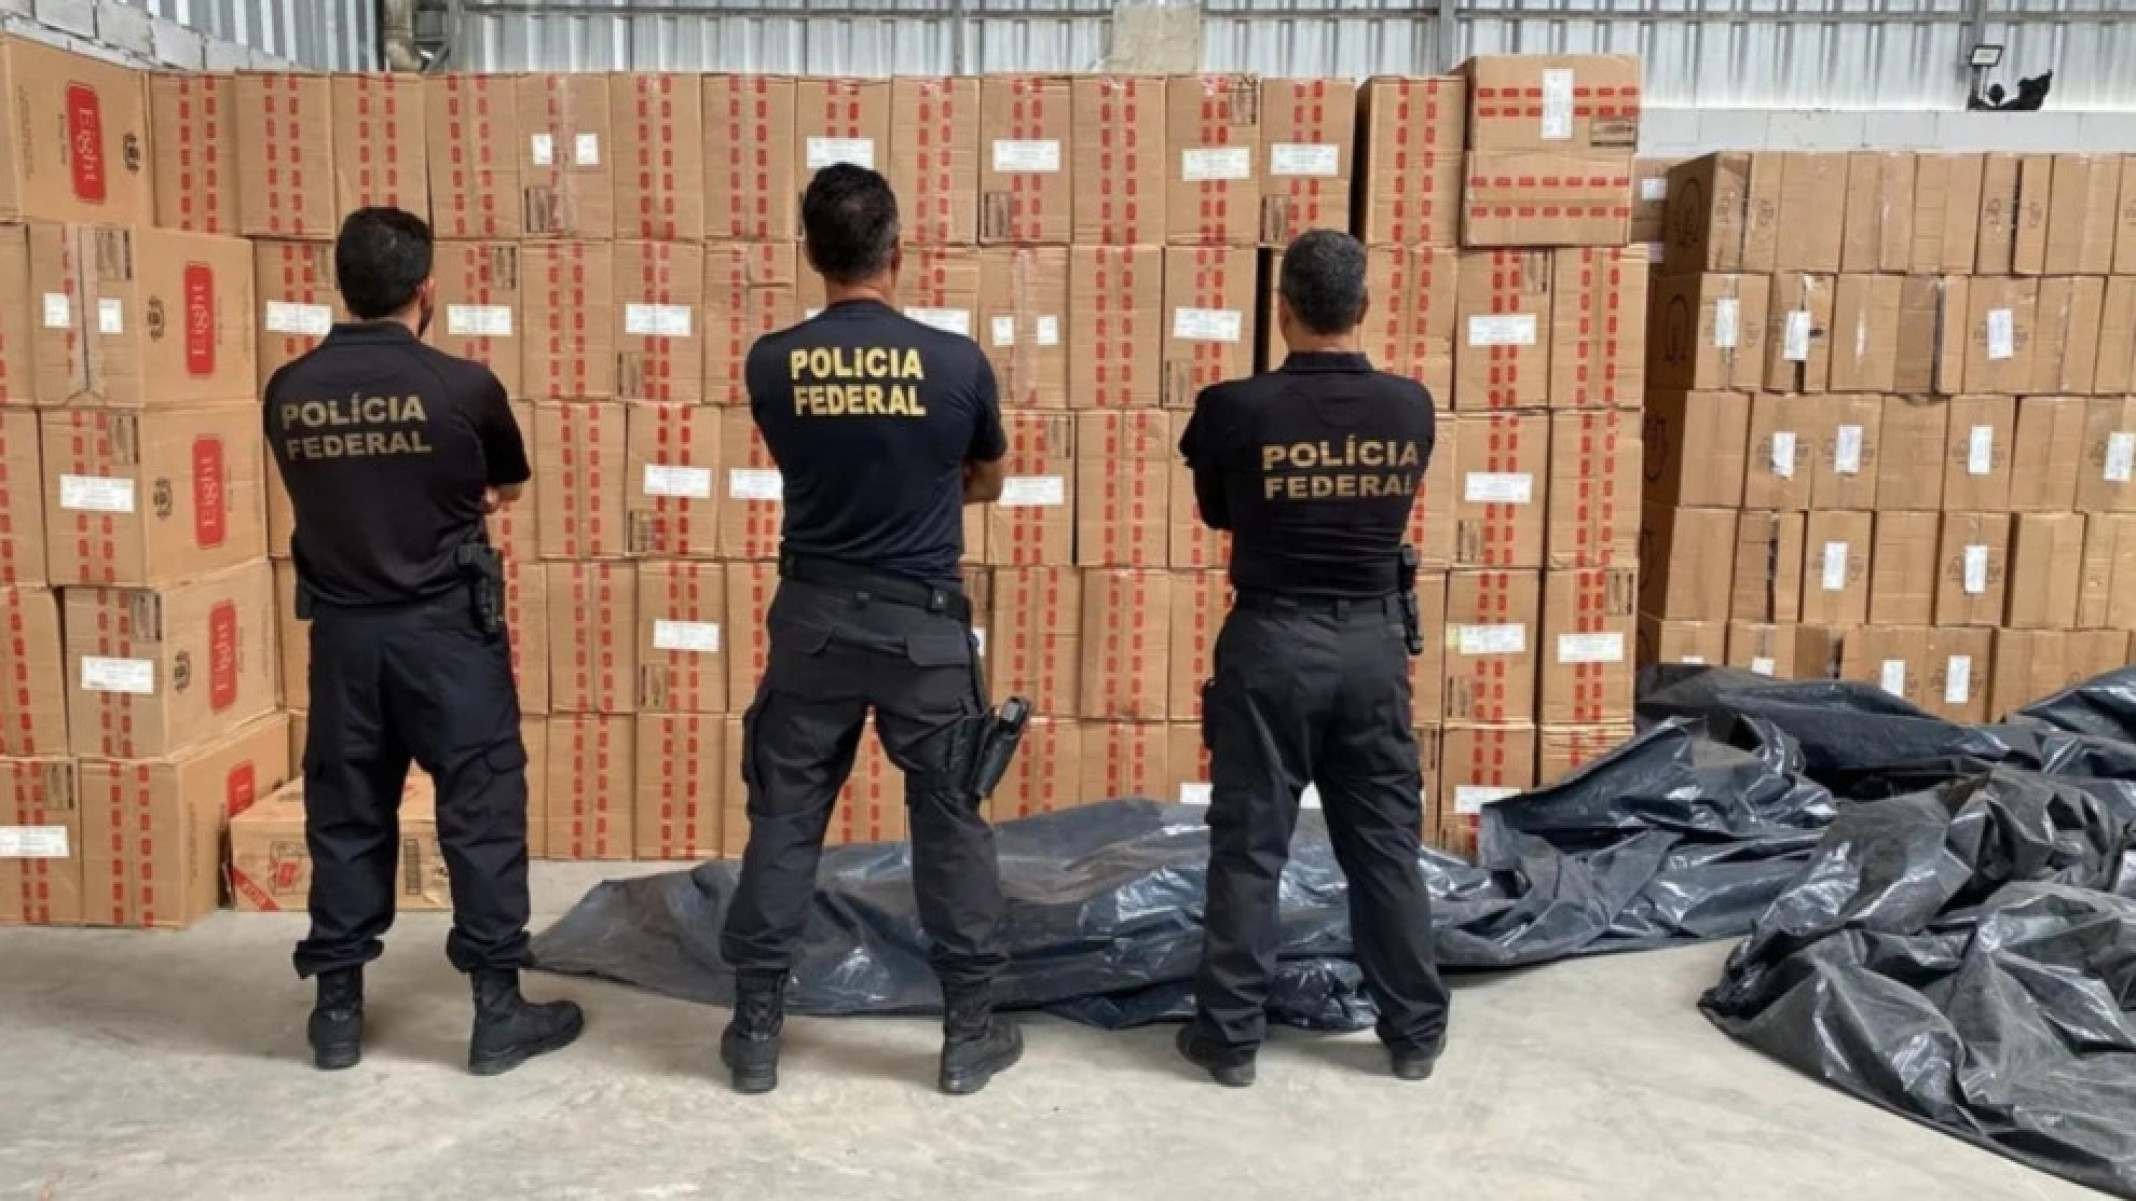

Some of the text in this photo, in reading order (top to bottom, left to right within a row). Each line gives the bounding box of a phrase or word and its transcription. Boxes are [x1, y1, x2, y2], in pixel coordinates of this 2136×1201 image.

[78, 107, 99, 181] Eight
[190, 284, 210, 356] Eight
[280, 391, 426, 430] POLÍCIA
[793, 384, 927, 416] FEDERAL
[285, 430, 433, 460] FEDERAL
[1261, 433, 1420, 471] POLÍCIA
[198, 456, 218, 529] Eight
[1263, 473, 1416, 499] FEDERAL
[214, 621, 234, 694] Eight
